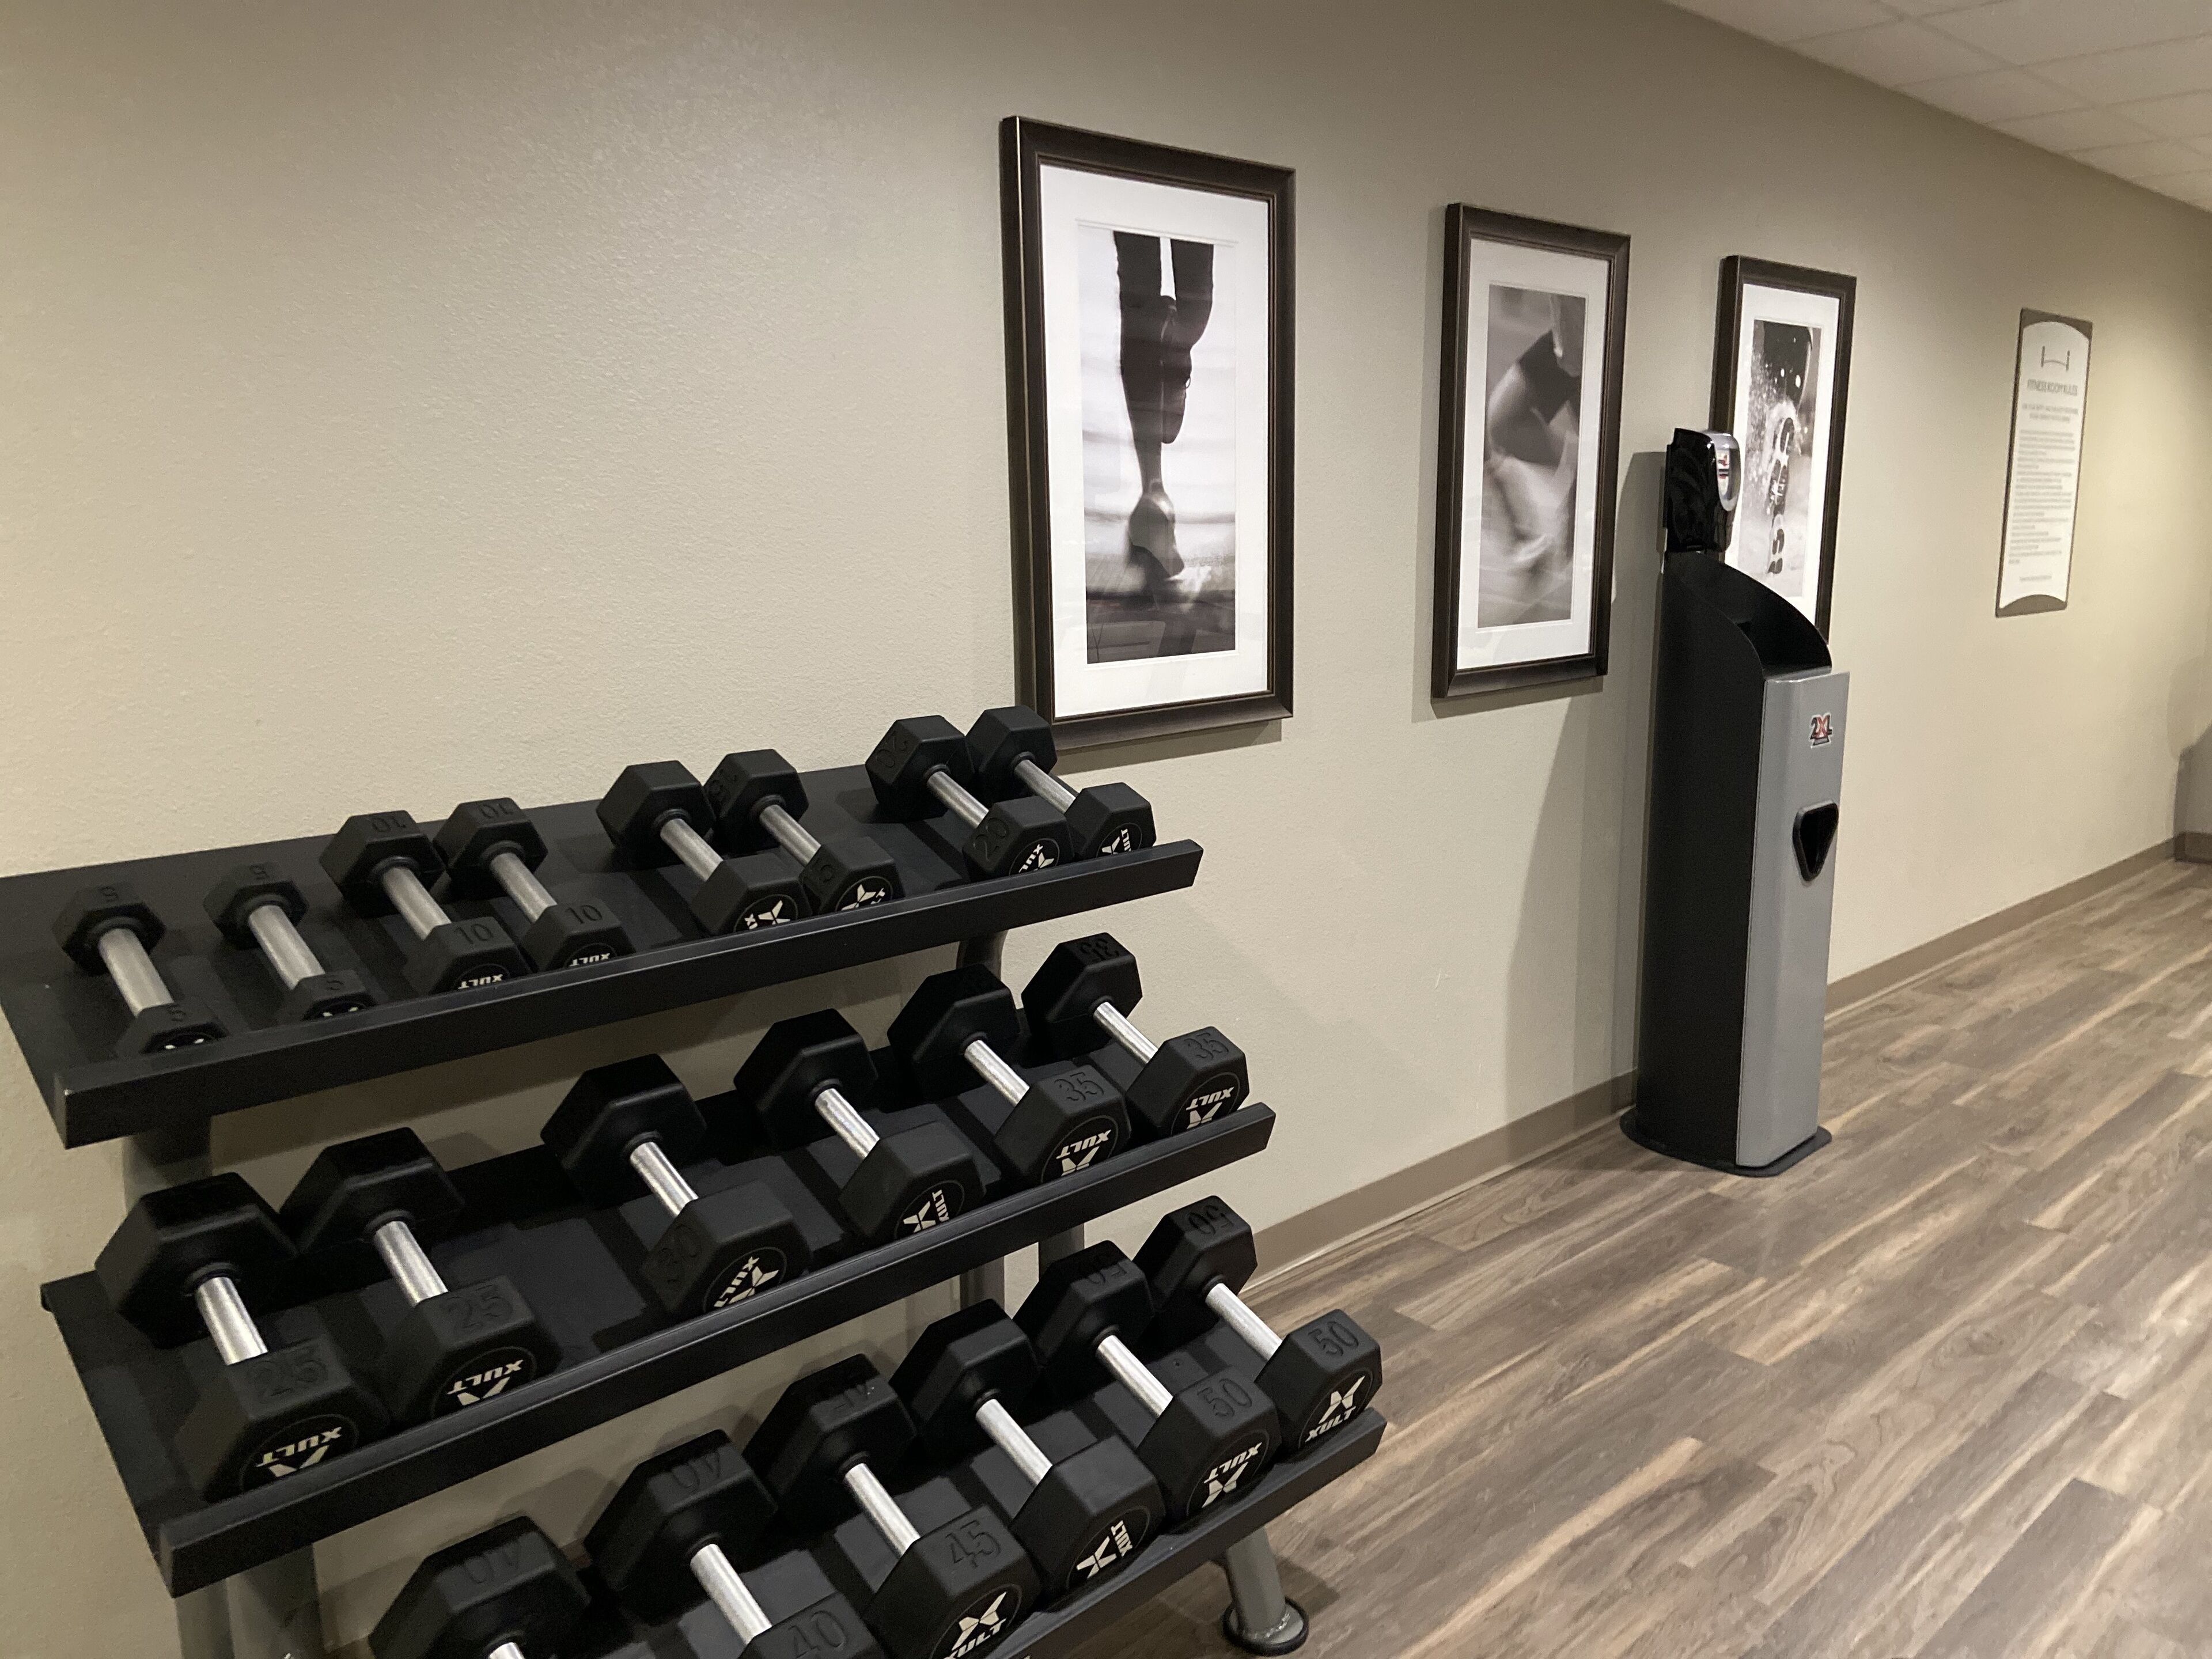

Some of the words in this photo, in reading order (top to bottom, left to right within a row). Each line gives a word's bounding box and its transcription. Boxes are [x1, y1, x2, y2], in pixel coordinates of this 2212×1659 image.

[564, 904, 603, 925] 10
[453, 923, 494, 946] 10
[569, 952, 611, 967] XULT
[457, 974, 503, 990] XULT
[1183, 1032, 1229, 1061] 35
[1054, 1071, 1105, 1101] 35
[1185, 1086, 1235, 1111] XULT
[1055, 1128, 1112, 1160] XULT
[931, 1189, 950, 1223] XULT
[1308, 1321, 1359, 1356] 50
[446, 1359, 525, 1396] XULT
[1197, 1378, 1253, 1418] 50
[1305, 1406, 1357, 1443] XULT
[255, 1426, 342, 1467] XULT
[1203, 1442, 1263, 1484] XULT
[945, 1520, 1001, 1568] 45
[1110, 1520, 1133, 1558] XULT
[787, 1609, 847, 1658] 40
